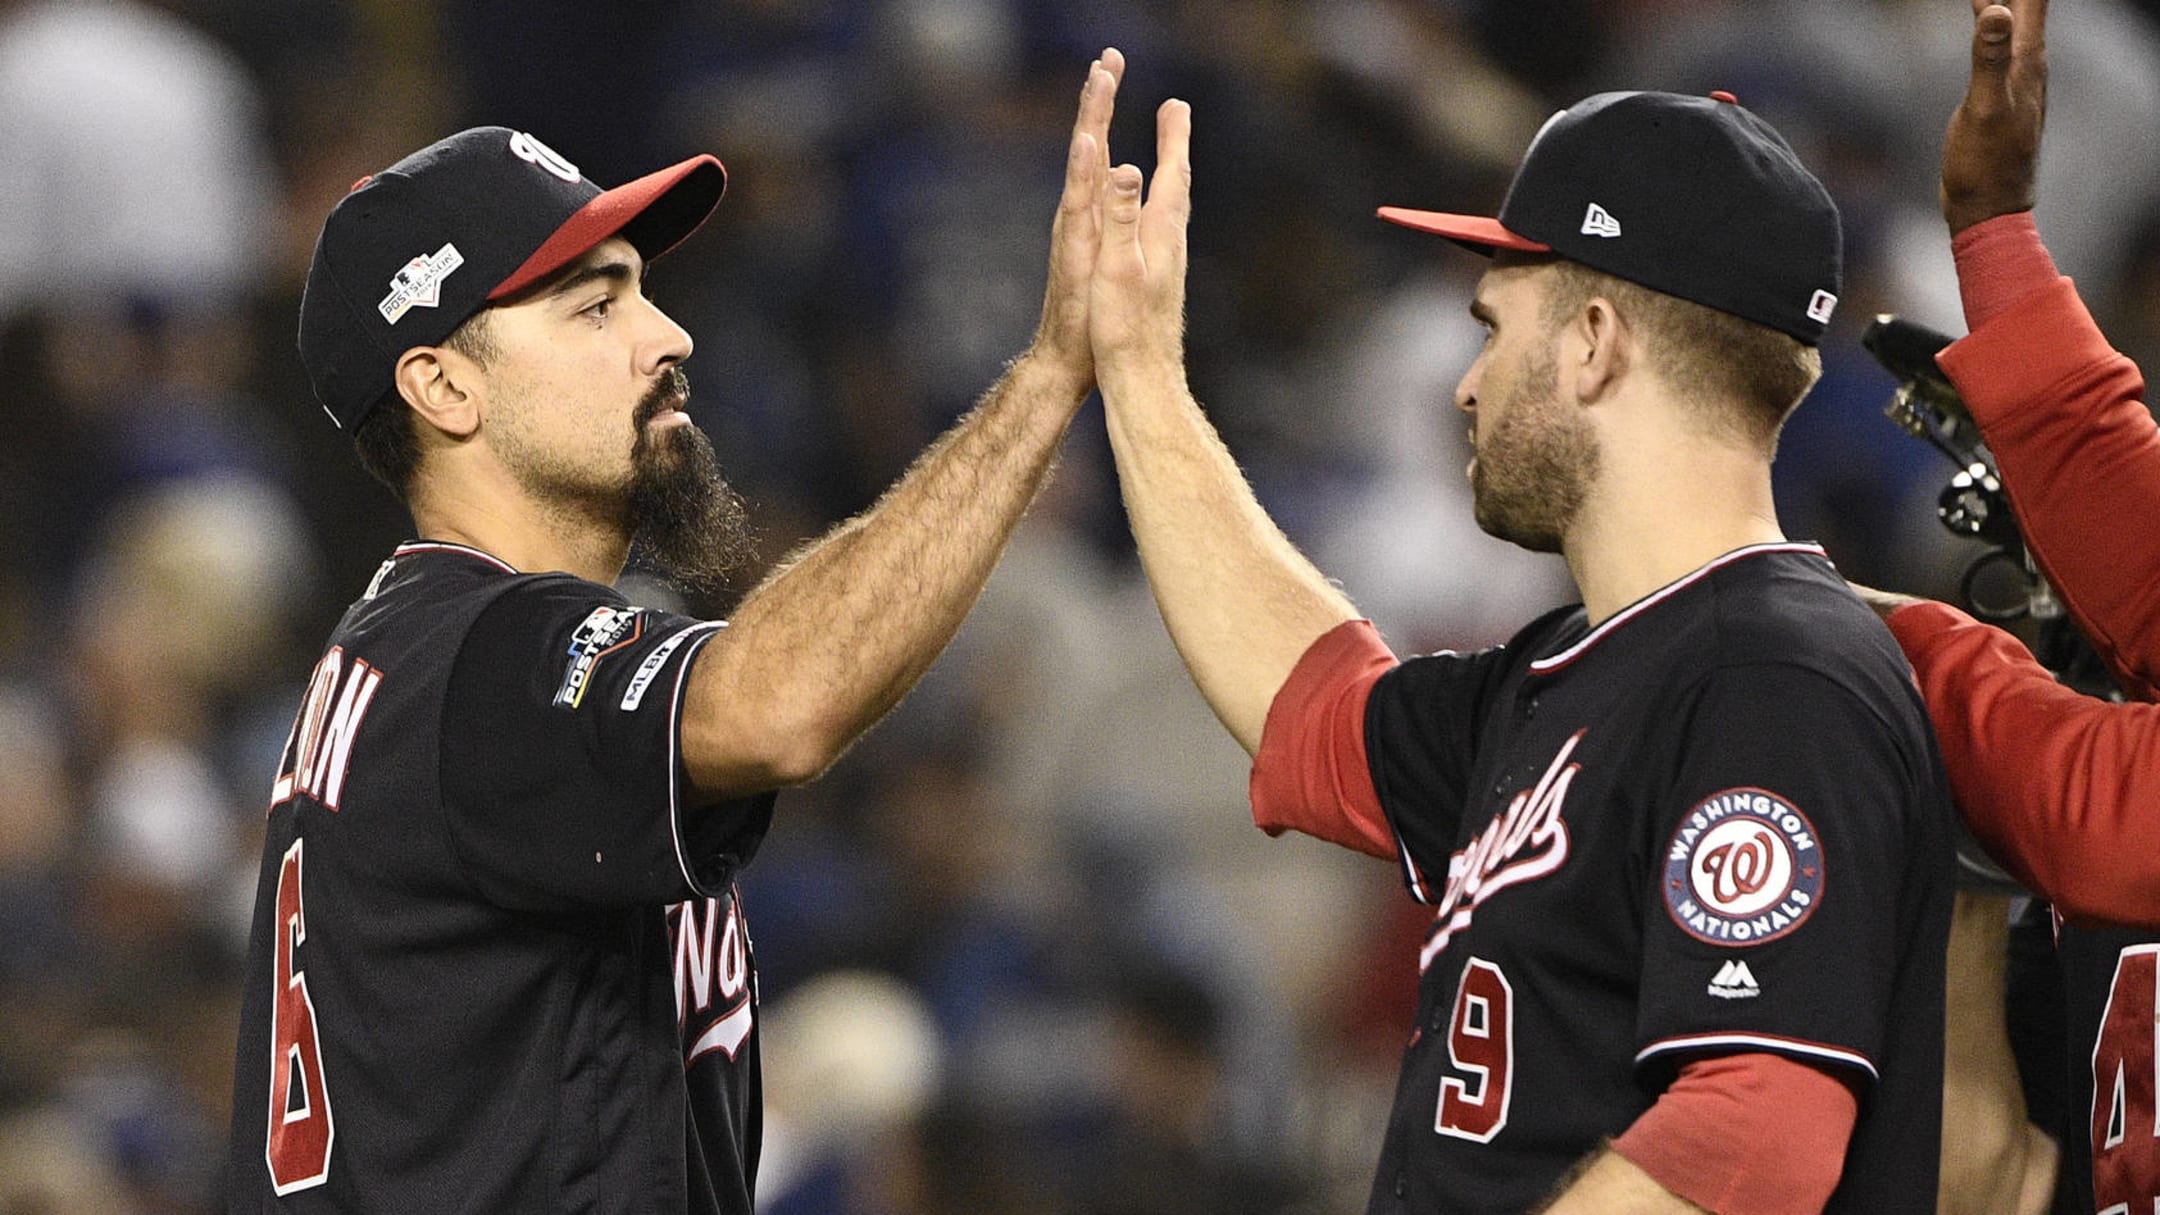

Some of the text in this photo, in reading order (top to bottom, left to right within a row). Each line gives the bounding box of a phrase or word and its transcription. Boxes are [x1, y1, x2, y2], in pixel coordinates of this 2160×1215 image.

[562, 605, 645, 704] POSTSEA
[1669, 793, 1815, 861] WASHINGTON
[1702, 831, 1774, 904] W
[1677, 889, 1811, 940] NATIONALS
[266, 837, 335, 1197] 6
[1434, 956, 1514, 1144] 9
[2090, 943, 2160, 1215] 4
